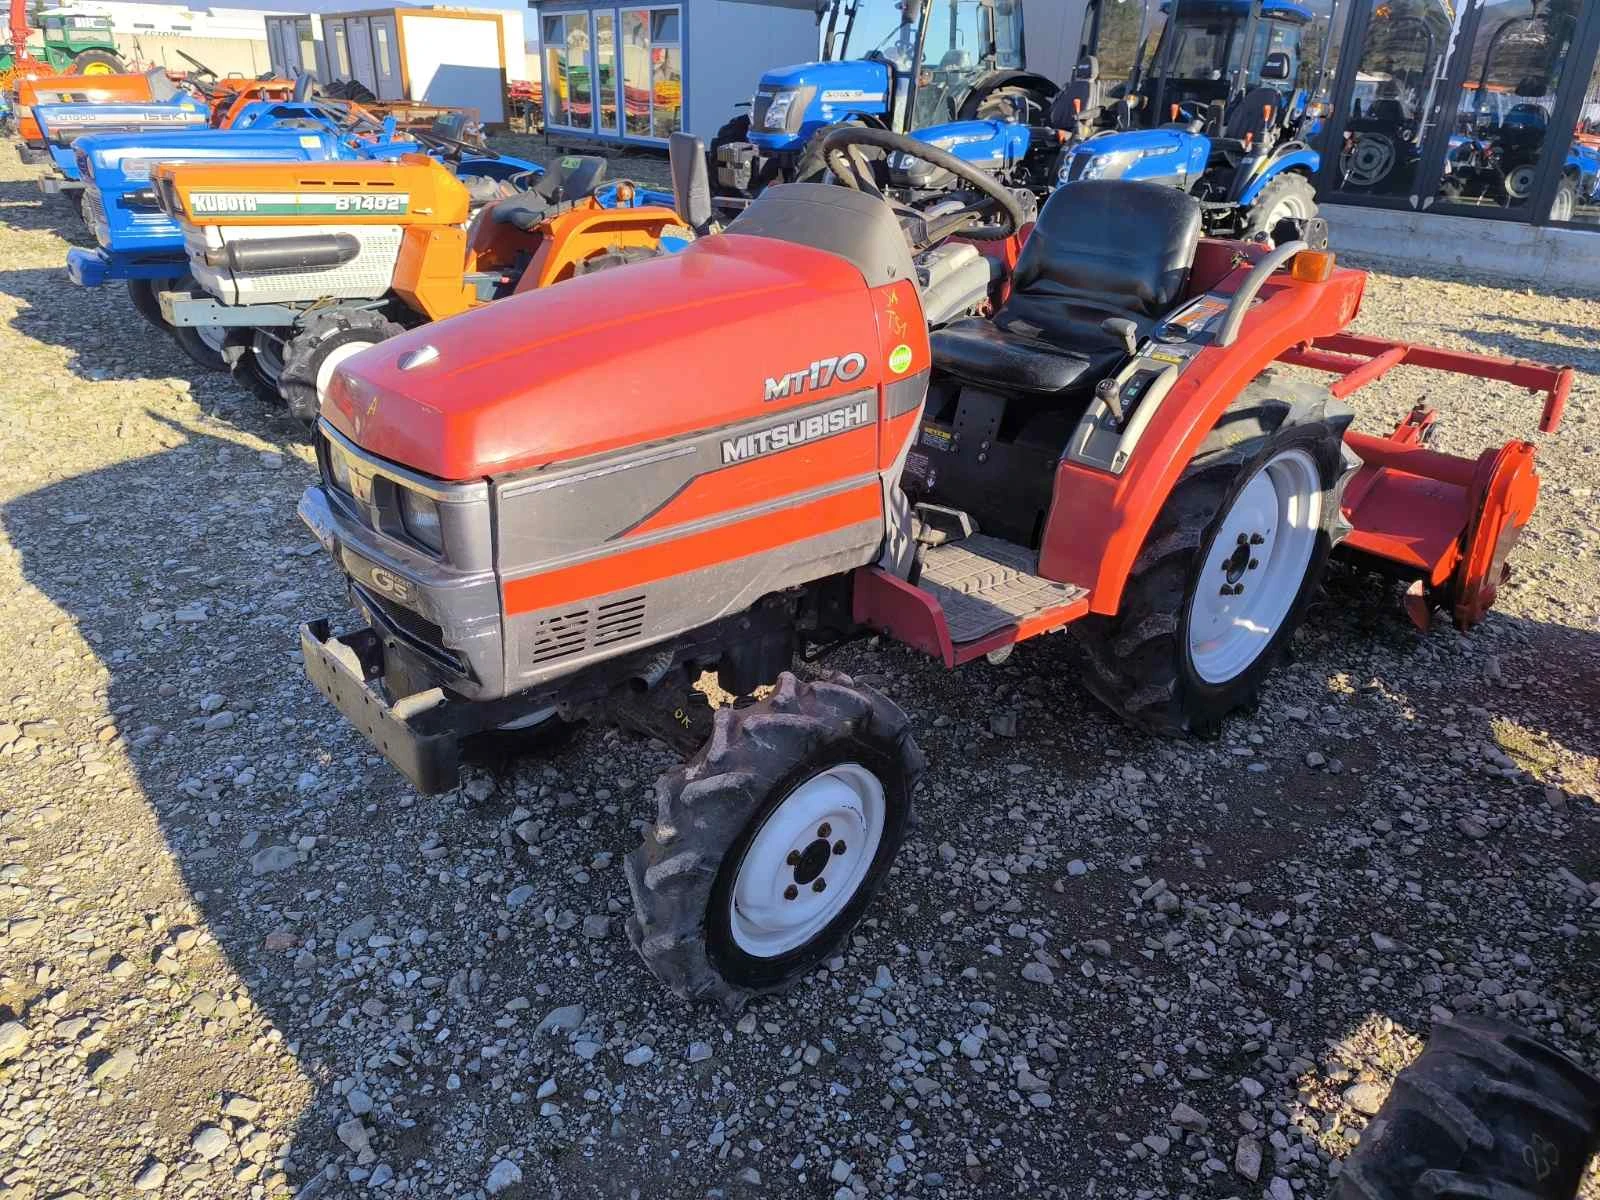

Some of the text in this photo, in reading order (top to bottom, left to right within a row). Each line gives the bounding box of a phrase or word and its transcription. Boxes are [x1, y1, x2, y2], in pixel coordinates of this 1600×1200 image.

[194, 195, 400, 213] KUBOTA B1402
[764, 352, 867, 401] MT170
[721, 402, 868, 464] MITSUBISHI
